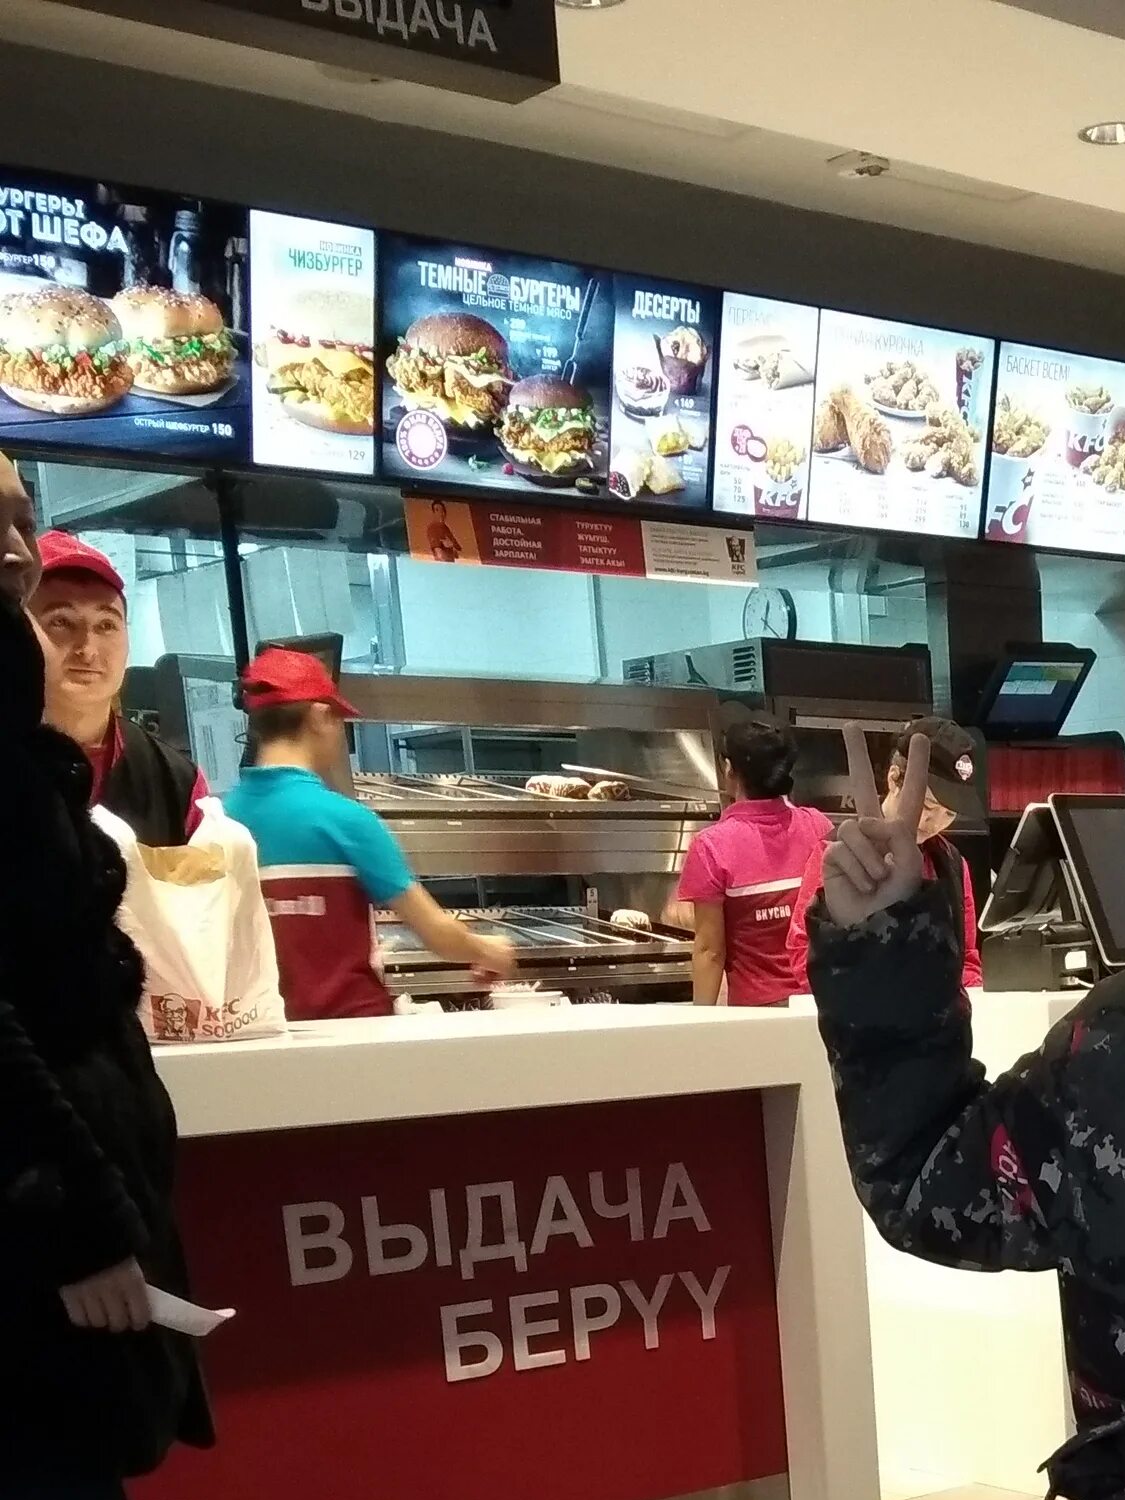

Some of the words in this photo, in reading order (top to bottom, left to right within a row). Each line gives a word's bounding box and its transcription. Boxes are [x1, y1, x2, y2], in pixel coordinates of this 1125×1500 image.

[31, 213, 129, 254] ШЕФА
[288, 247, 363, 277] ЧИЗБУРГЕР
[417, 260, 488, 296] ТЕМНЫЕ
[510, 276, 581, 312] БУРГЕРЫ
[463, 293, 507, 311] ЦЕЛЬНОЕ
[508, 300, 545, 316] ТЕМНОЕ
[546, 307, 572, 321] МЯСО
[632, 290, 700, 324] ДЕСЕРТЫ
[1006, 354, 1041, 377] БАСКЕТ
[212, 422, 233, 437] 150
[349, 449, 366, 461] 129
[759, 489, 799, 508] KFC
[490, 513, 542, 525] СТАБИЛЬНАЯ
[493, 537, 542, 549] ДОСТОЙНАЯ
[494, 549, 537, 560] ЗАРПЛАТА!
[755, 904, 791, 922] ВКУСНО
[282, 1161, 713, 1287] ВЫДАЧА
[439, 1265, 732, 1383] БЕРҮҮ
